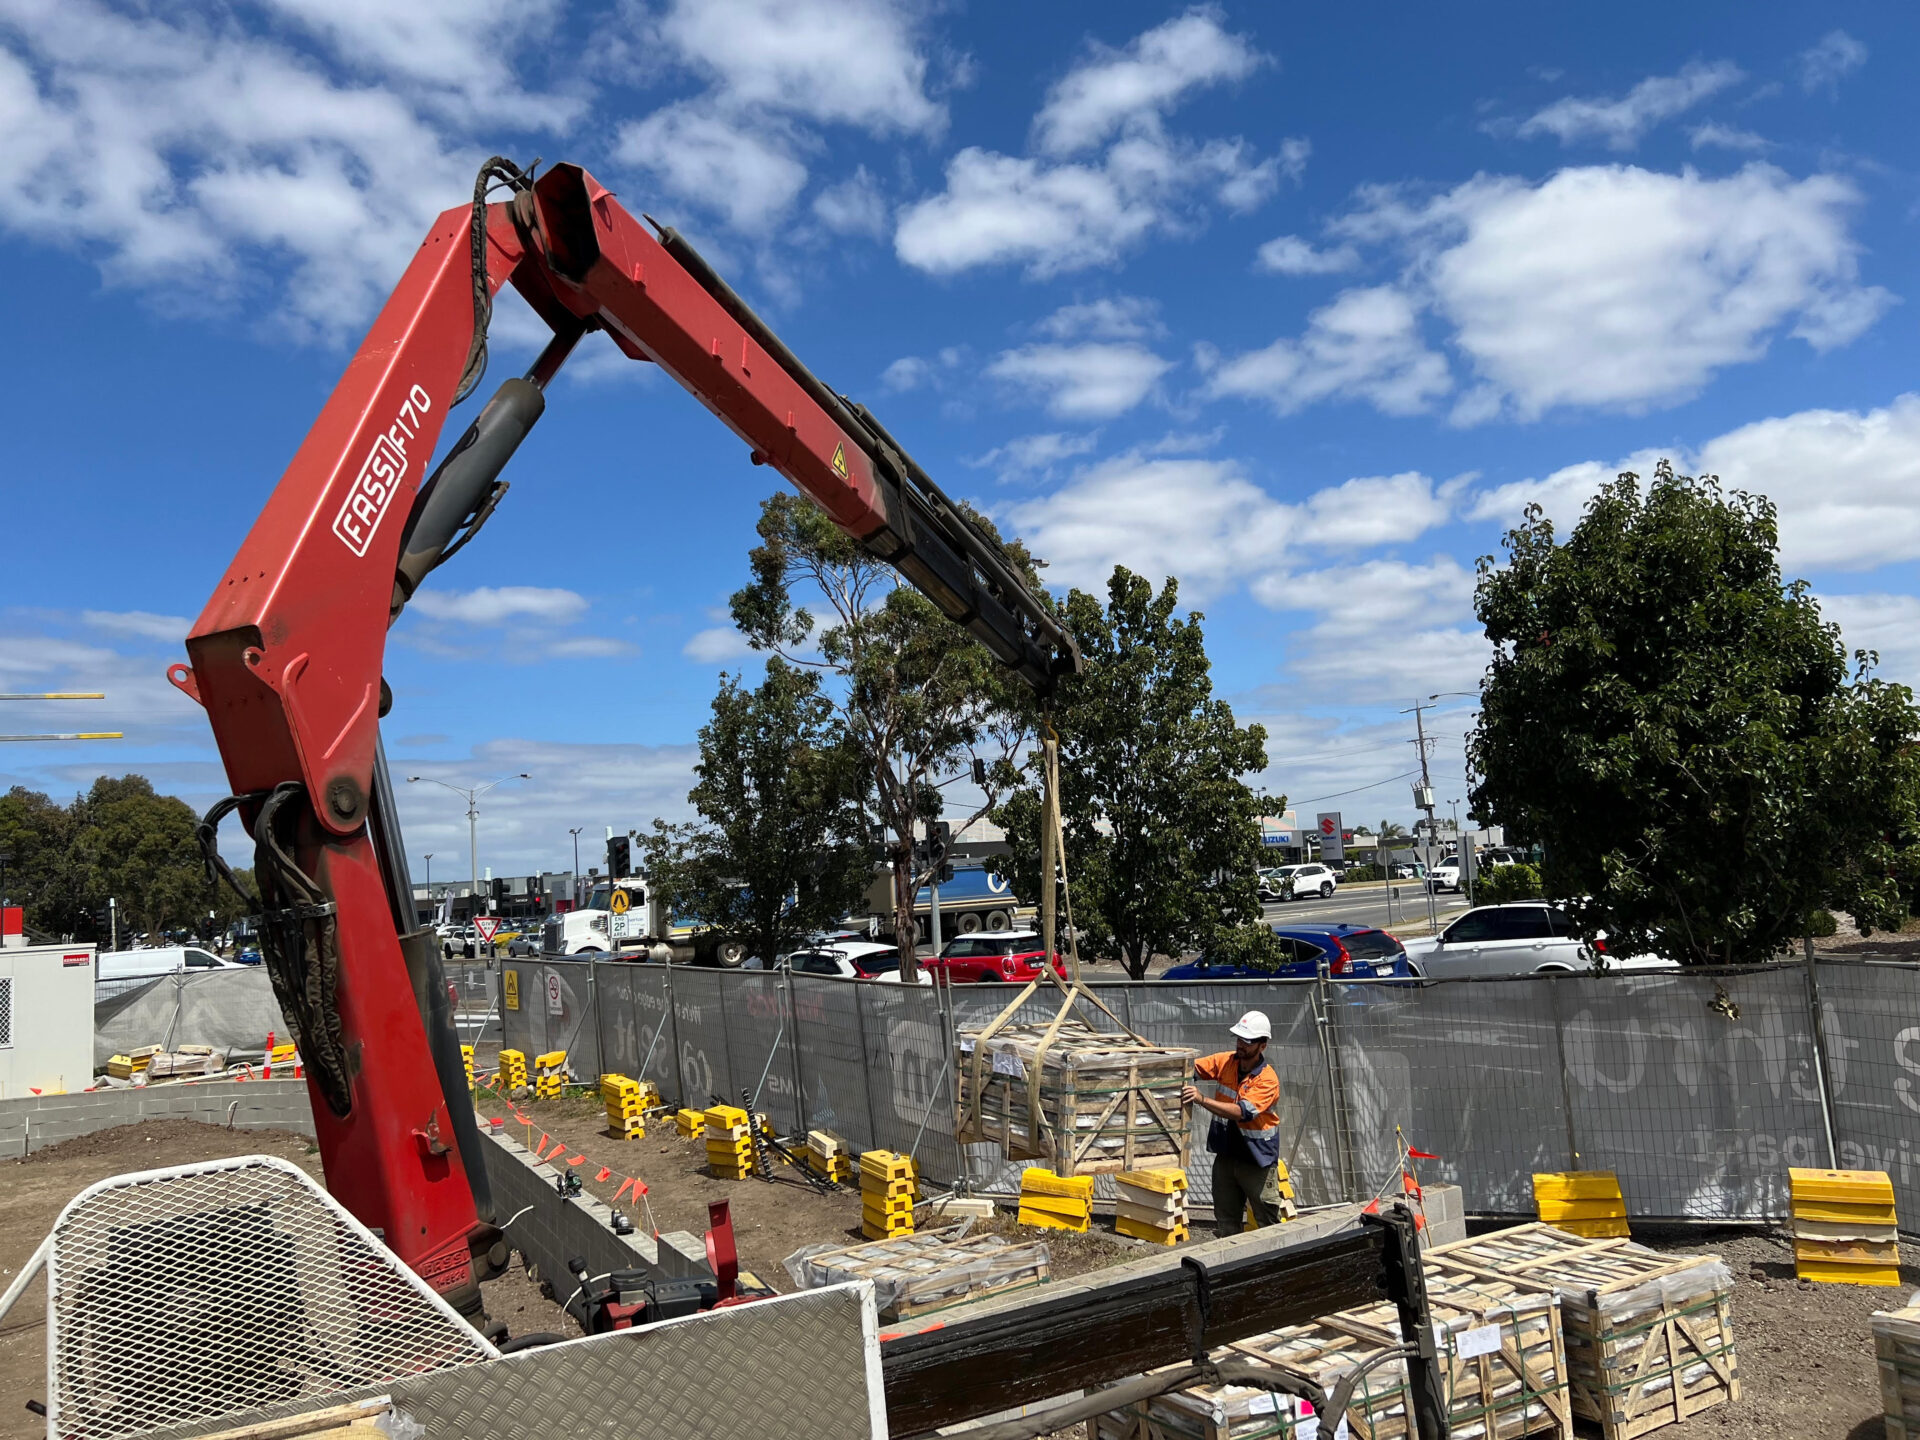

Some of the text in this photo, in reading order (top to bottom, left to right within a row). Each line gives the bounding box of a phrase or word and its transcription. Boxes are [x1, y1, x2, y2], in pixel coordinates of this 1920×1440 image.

[340, 383, 432, 547] FASSI F170
[614, 922, 626, 931] 2P
